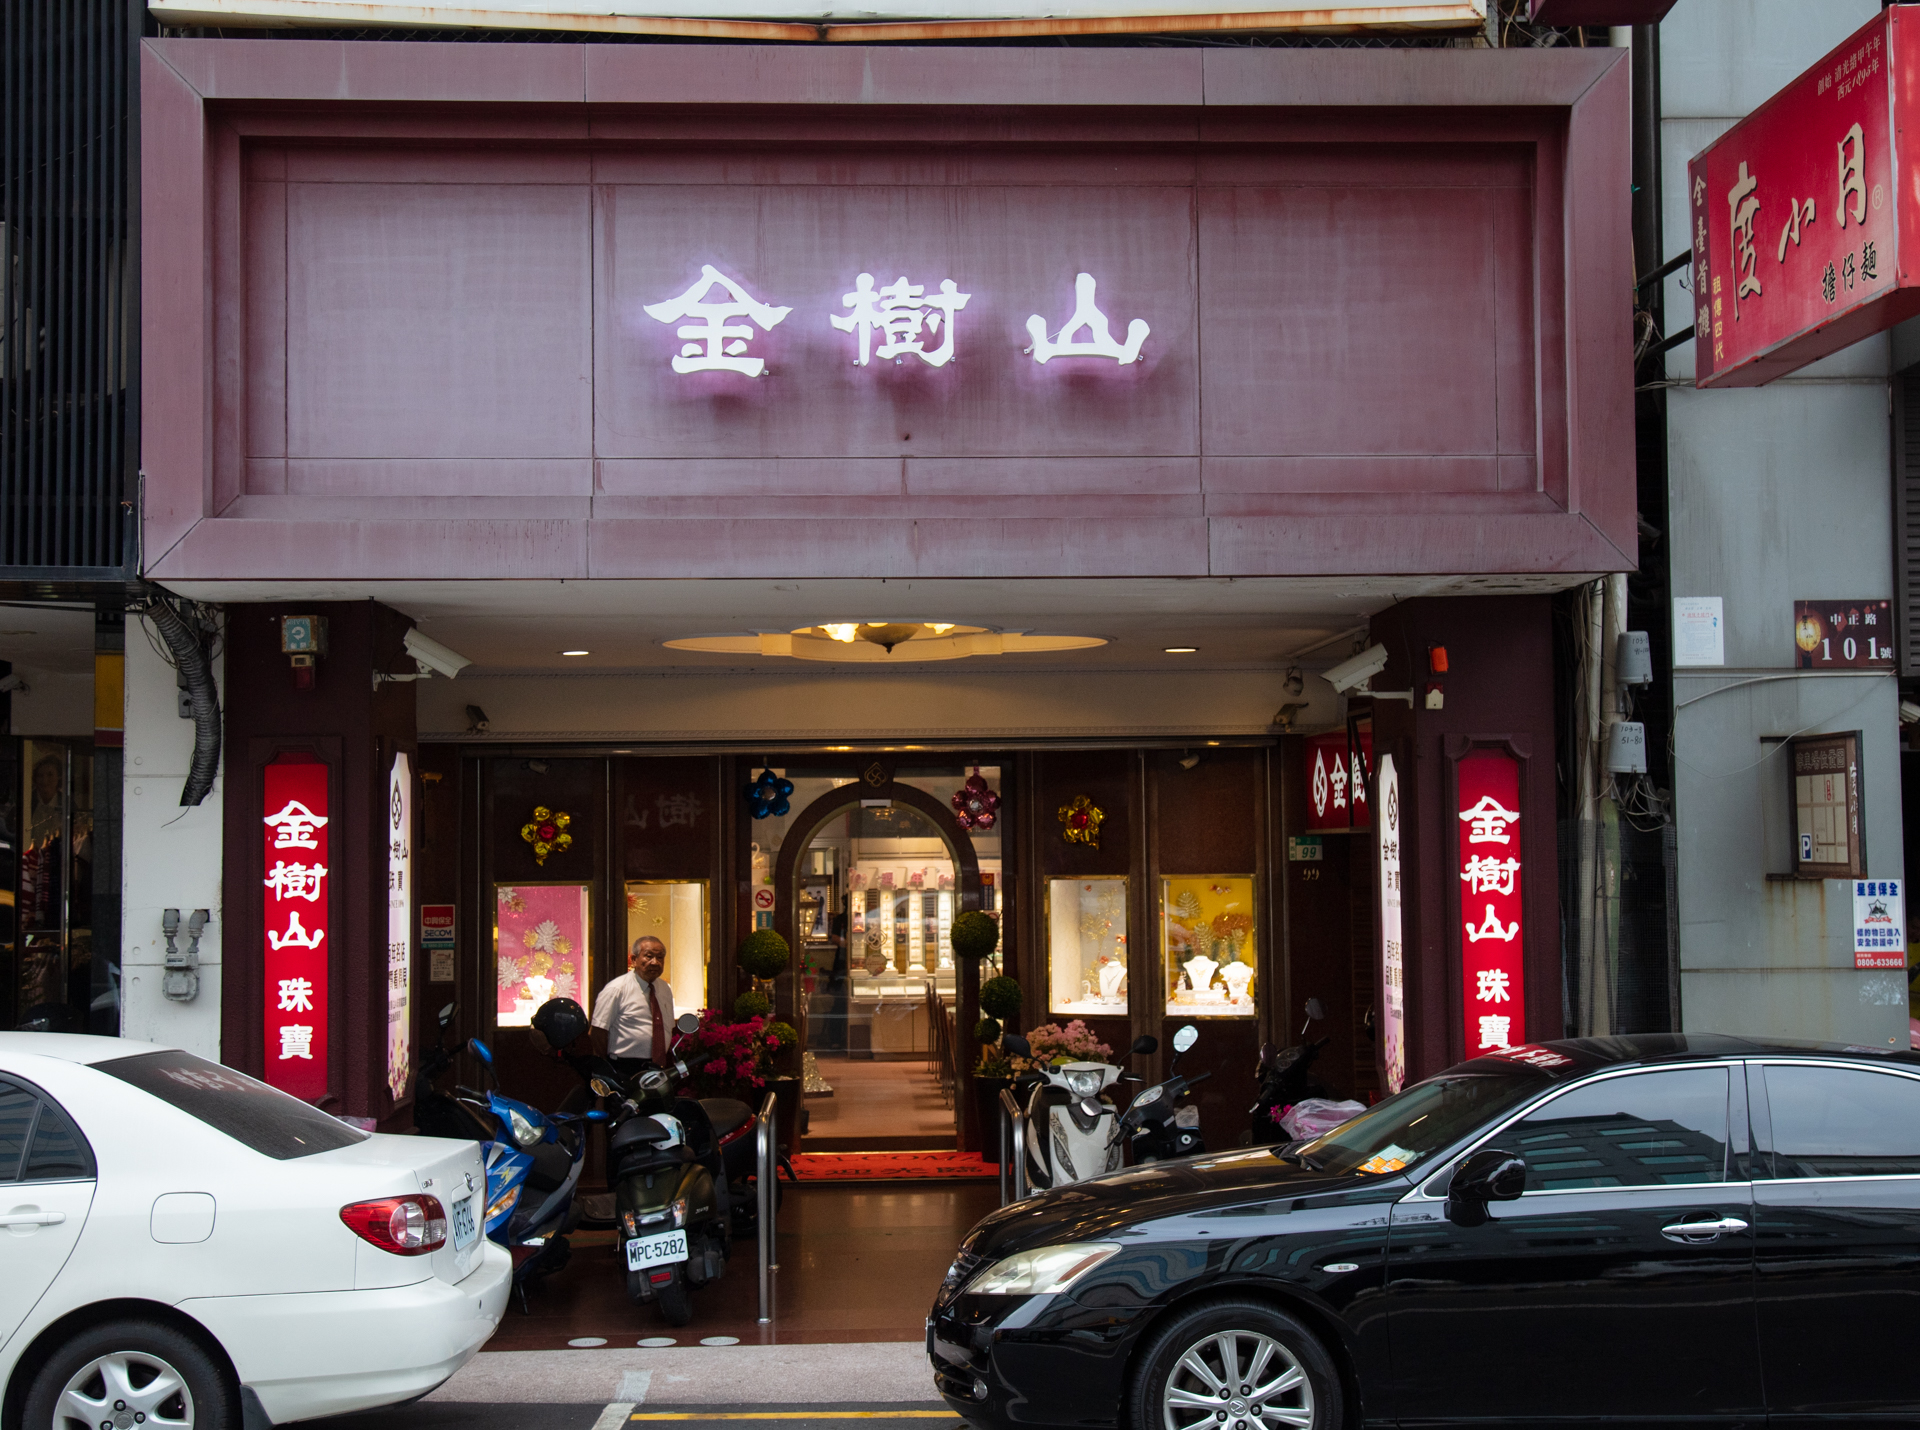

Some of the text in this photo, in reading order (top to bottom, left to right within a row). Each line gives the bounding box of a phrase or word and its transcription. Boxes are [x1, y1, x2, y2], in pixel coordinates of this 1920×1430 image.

[1728, 122, 1866, 322] 度小月
[643, 264, 1150, 378] 金樹山
[1829, 613, 1877, 625] 中正路
[1302, 847, 1317, 859] 99
[1857, 882, 1898, 897] 星堡保全
[263, 800, 329, 1060] 金樹山珠寶
[1459, 795, 1521, 1049] 金樹山珠寶
[424, 929, 452, 938] SECOM
[1857, 958, 1903, 967] 0800-633666
[629, 1238, 686, 1264] MPC-5282
